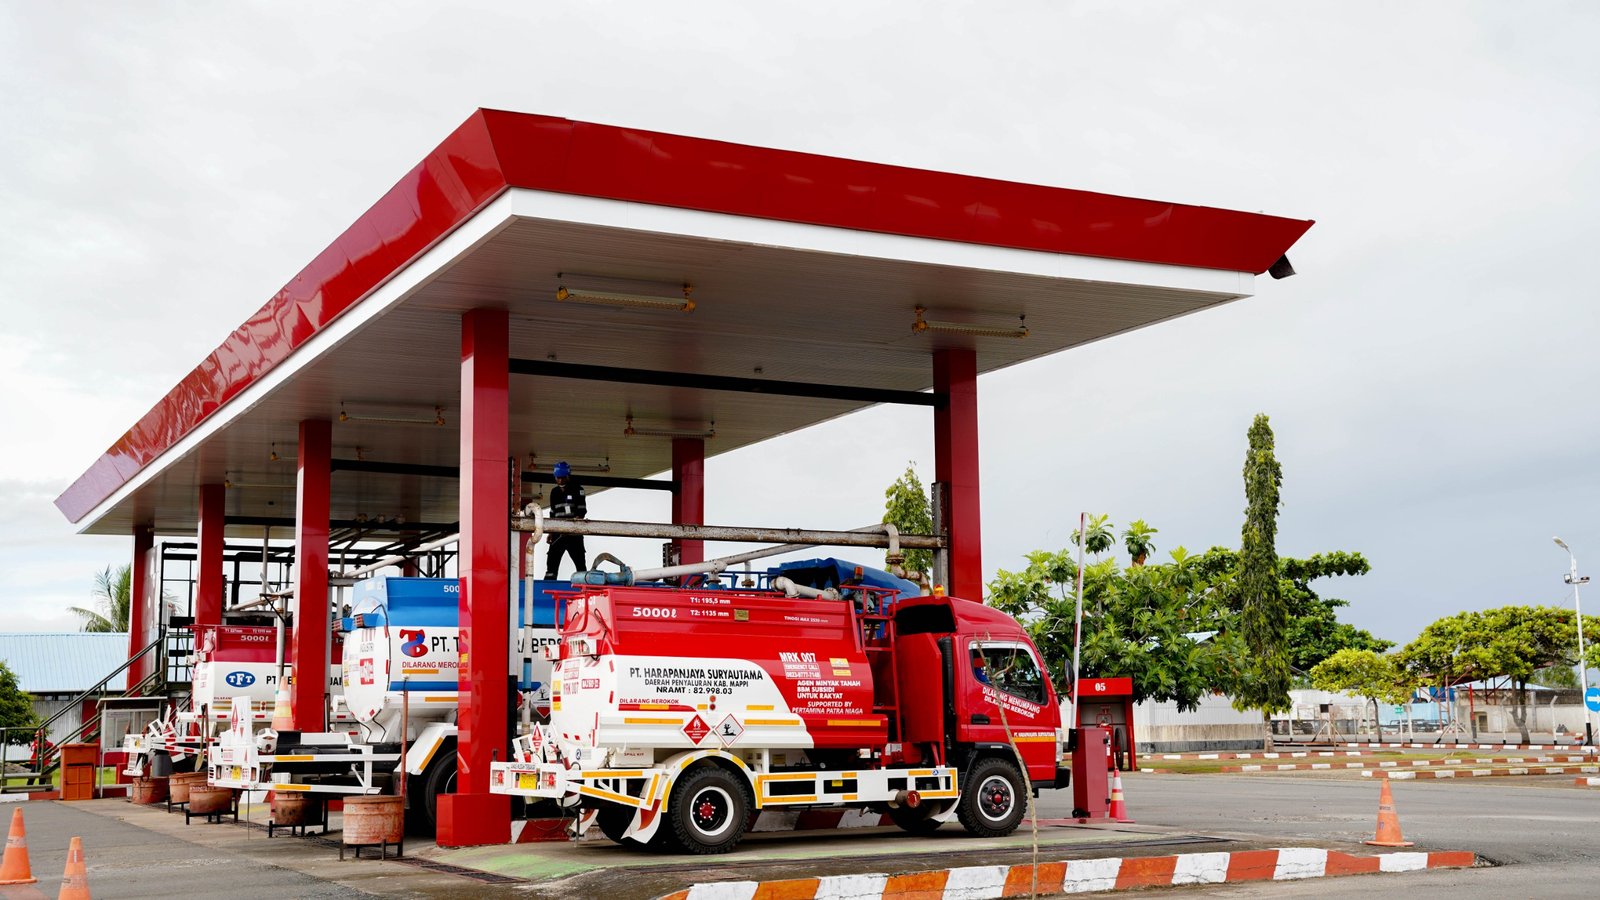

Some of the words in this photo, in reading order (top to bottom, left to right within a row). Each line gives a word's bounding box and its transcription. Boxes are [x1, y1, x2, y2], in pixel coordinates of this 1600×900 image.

[432, 636, 450, 652] PT.
[779, 652, 801, 662] MRK
[801, 652, 816, 662] 007
[630, 667, 641, 678] PT.
[644, 668, 705, 679] HARAPANJAYA
[708, 669, 763, 680] SURYAUTAMA
[1095, 683, 1106, 691] 05
[982, 686, 1008, 701] DILANG
[1008, 695, 1040, 714] MENUMPANG
